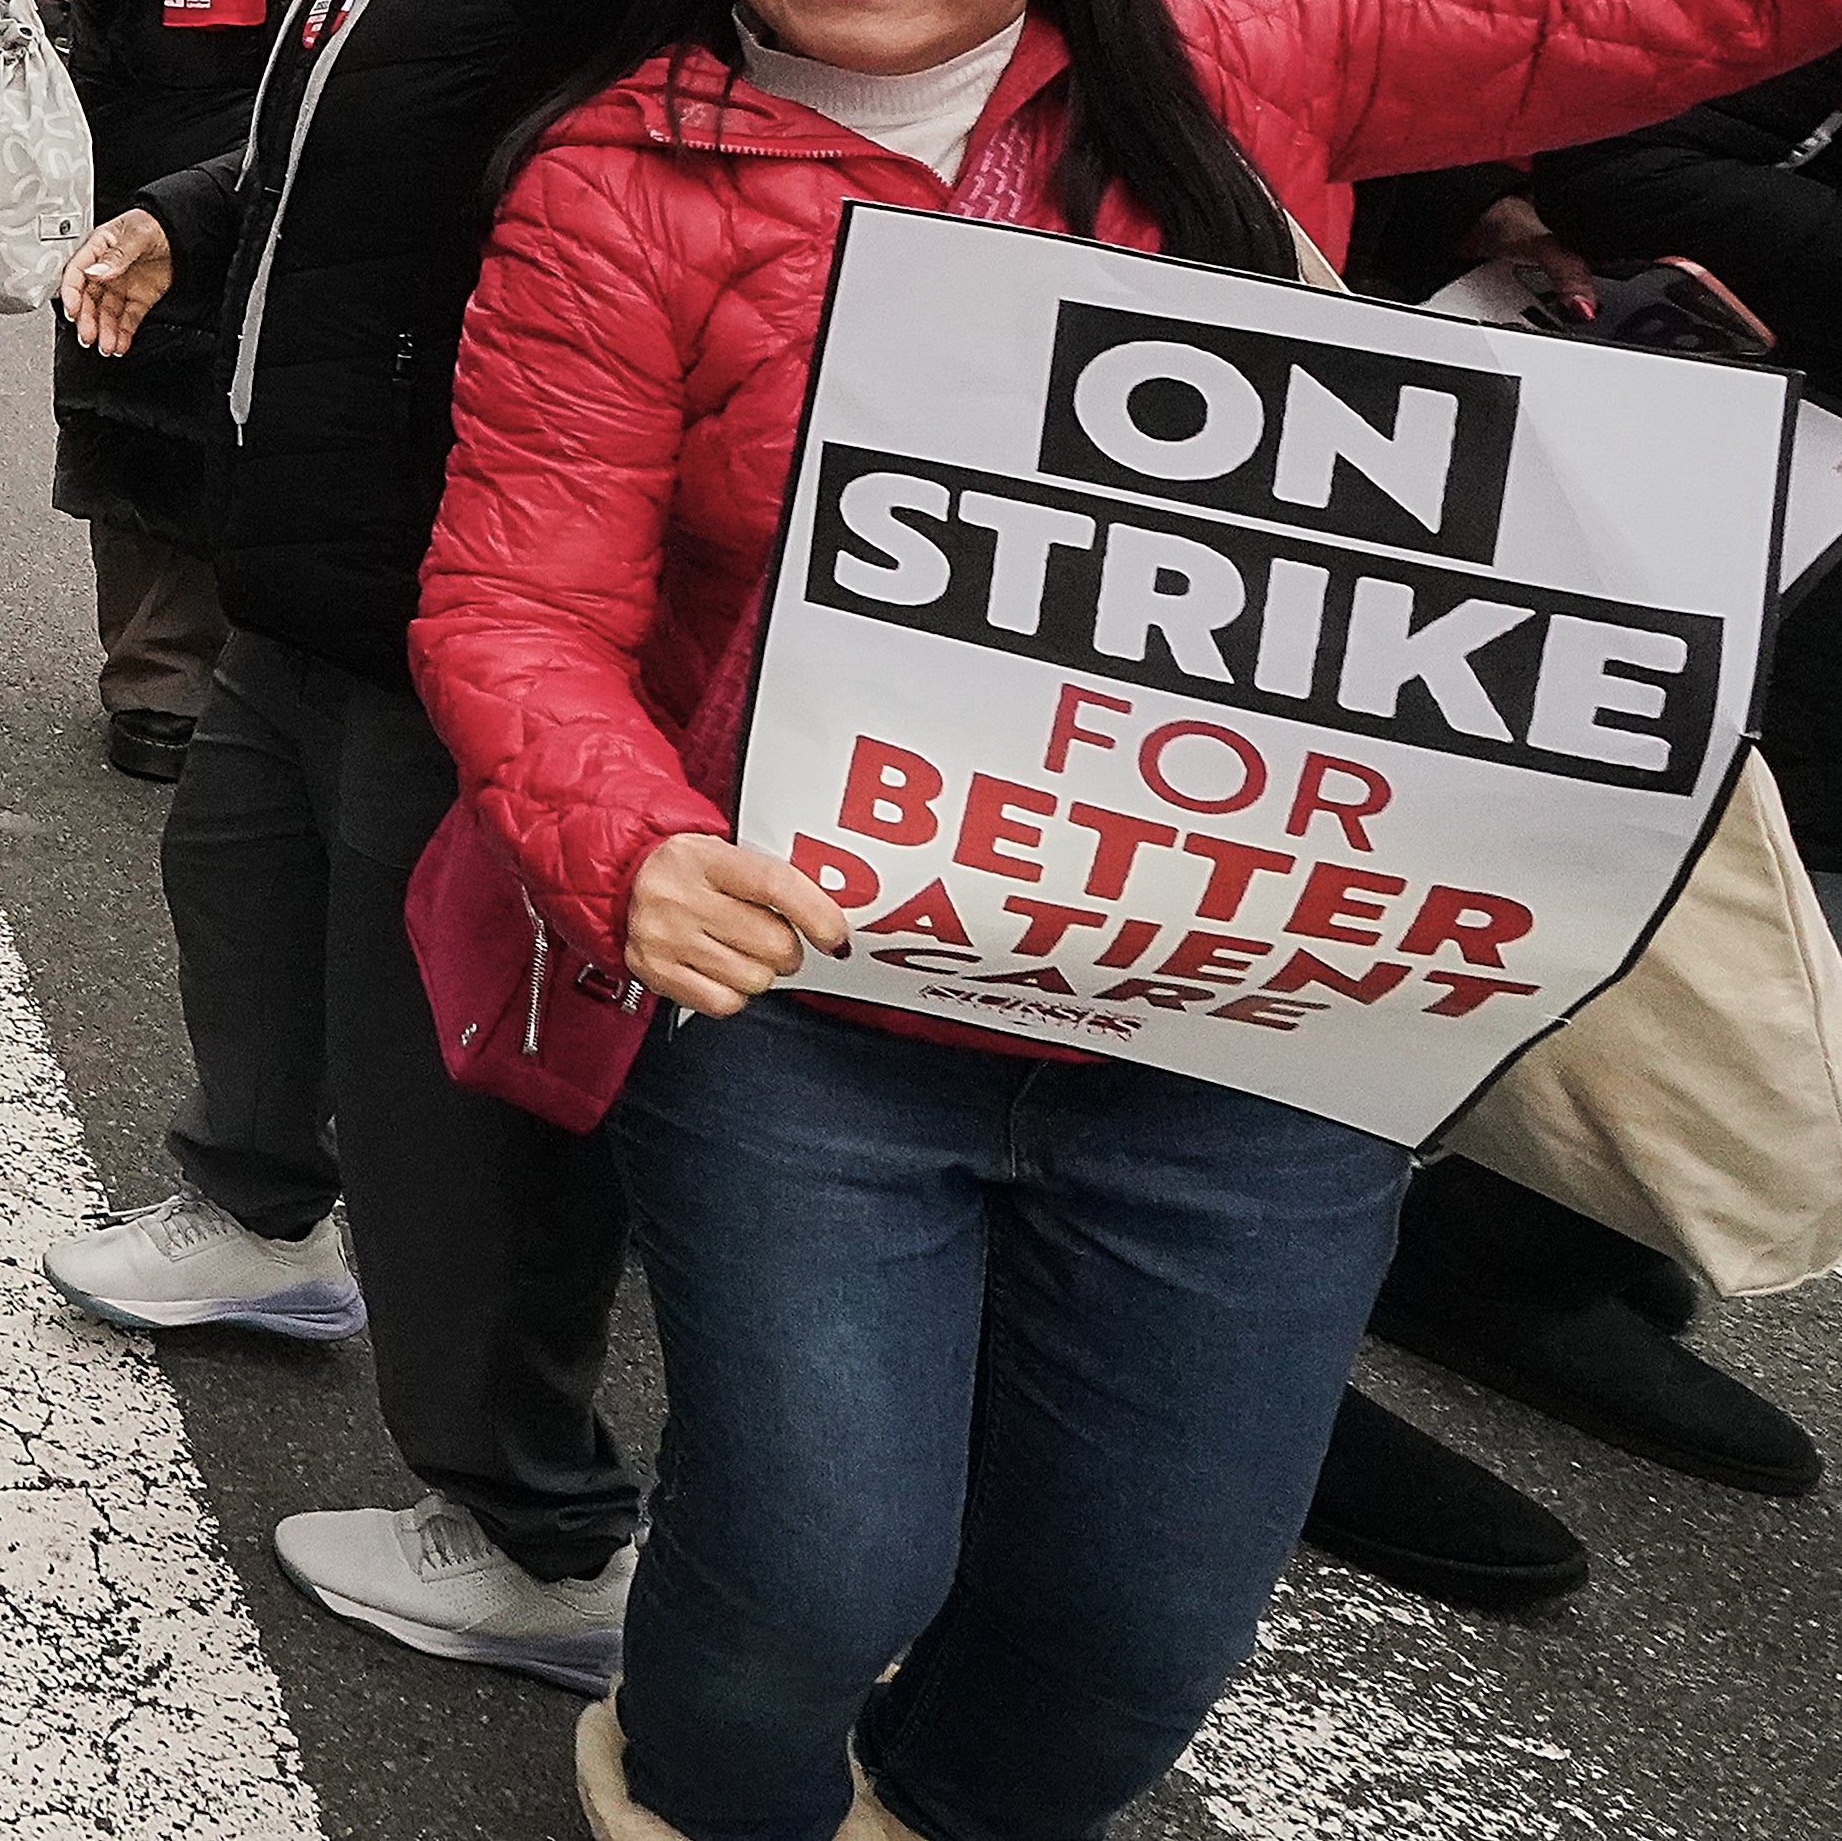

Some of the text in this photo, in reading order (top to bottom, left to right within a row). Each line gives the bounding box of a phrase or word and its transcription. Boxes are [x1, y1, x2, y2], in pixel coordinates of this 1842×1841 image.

[1073, 338, 1459, 535] ON
[833, 472, 1692, 771] STRIKE
[837, 735, 1535, 969] BETTER
[1043, 683, 1392, 852] FOR
[789, 832, 1540, 1022] PATIENT
[869, 946, 1330, 1033] CARE
